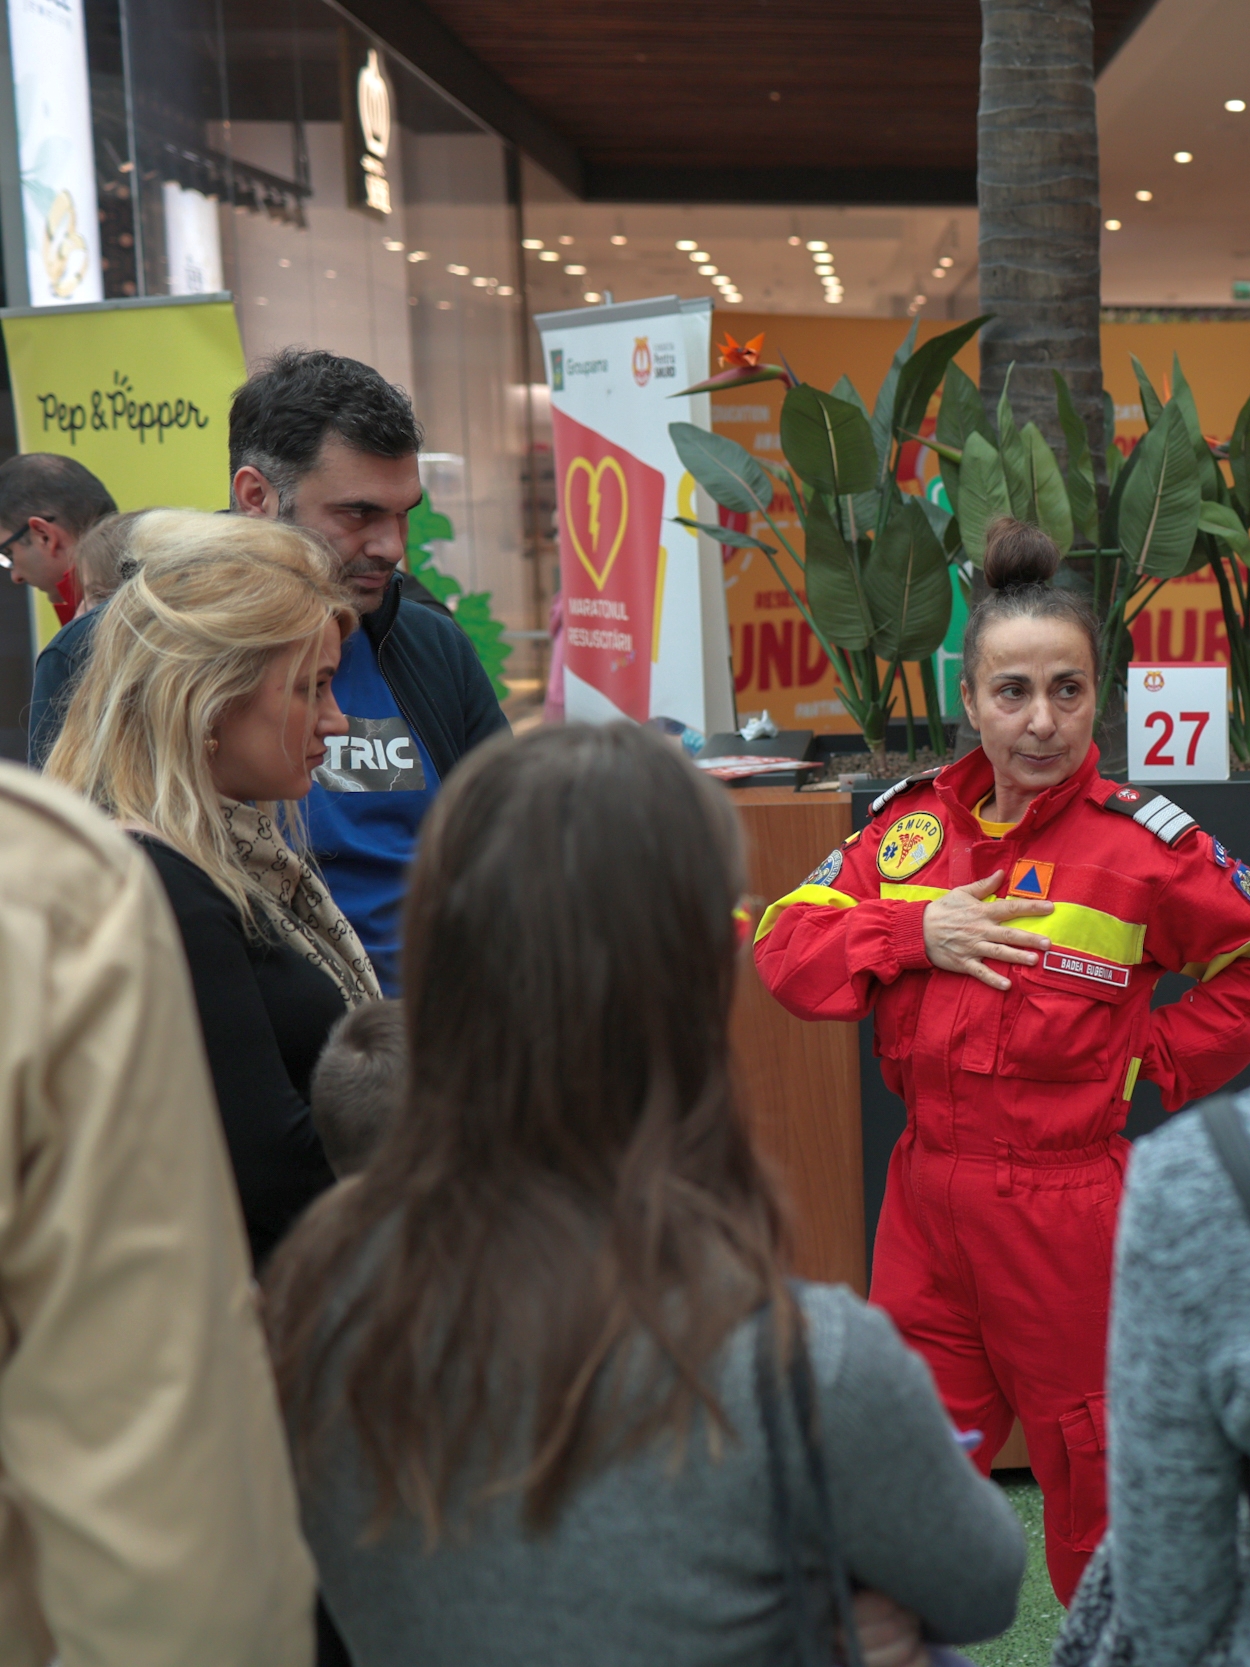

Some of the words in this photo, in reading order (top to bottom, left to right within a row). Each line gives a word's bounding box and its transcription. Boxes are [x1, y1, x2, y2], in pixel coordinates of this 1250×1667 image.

[1144, 711, 1210, 766] 27
[896, 818, 938, 837] SMURD
[1060, 958, 1084, 972] BADEA
